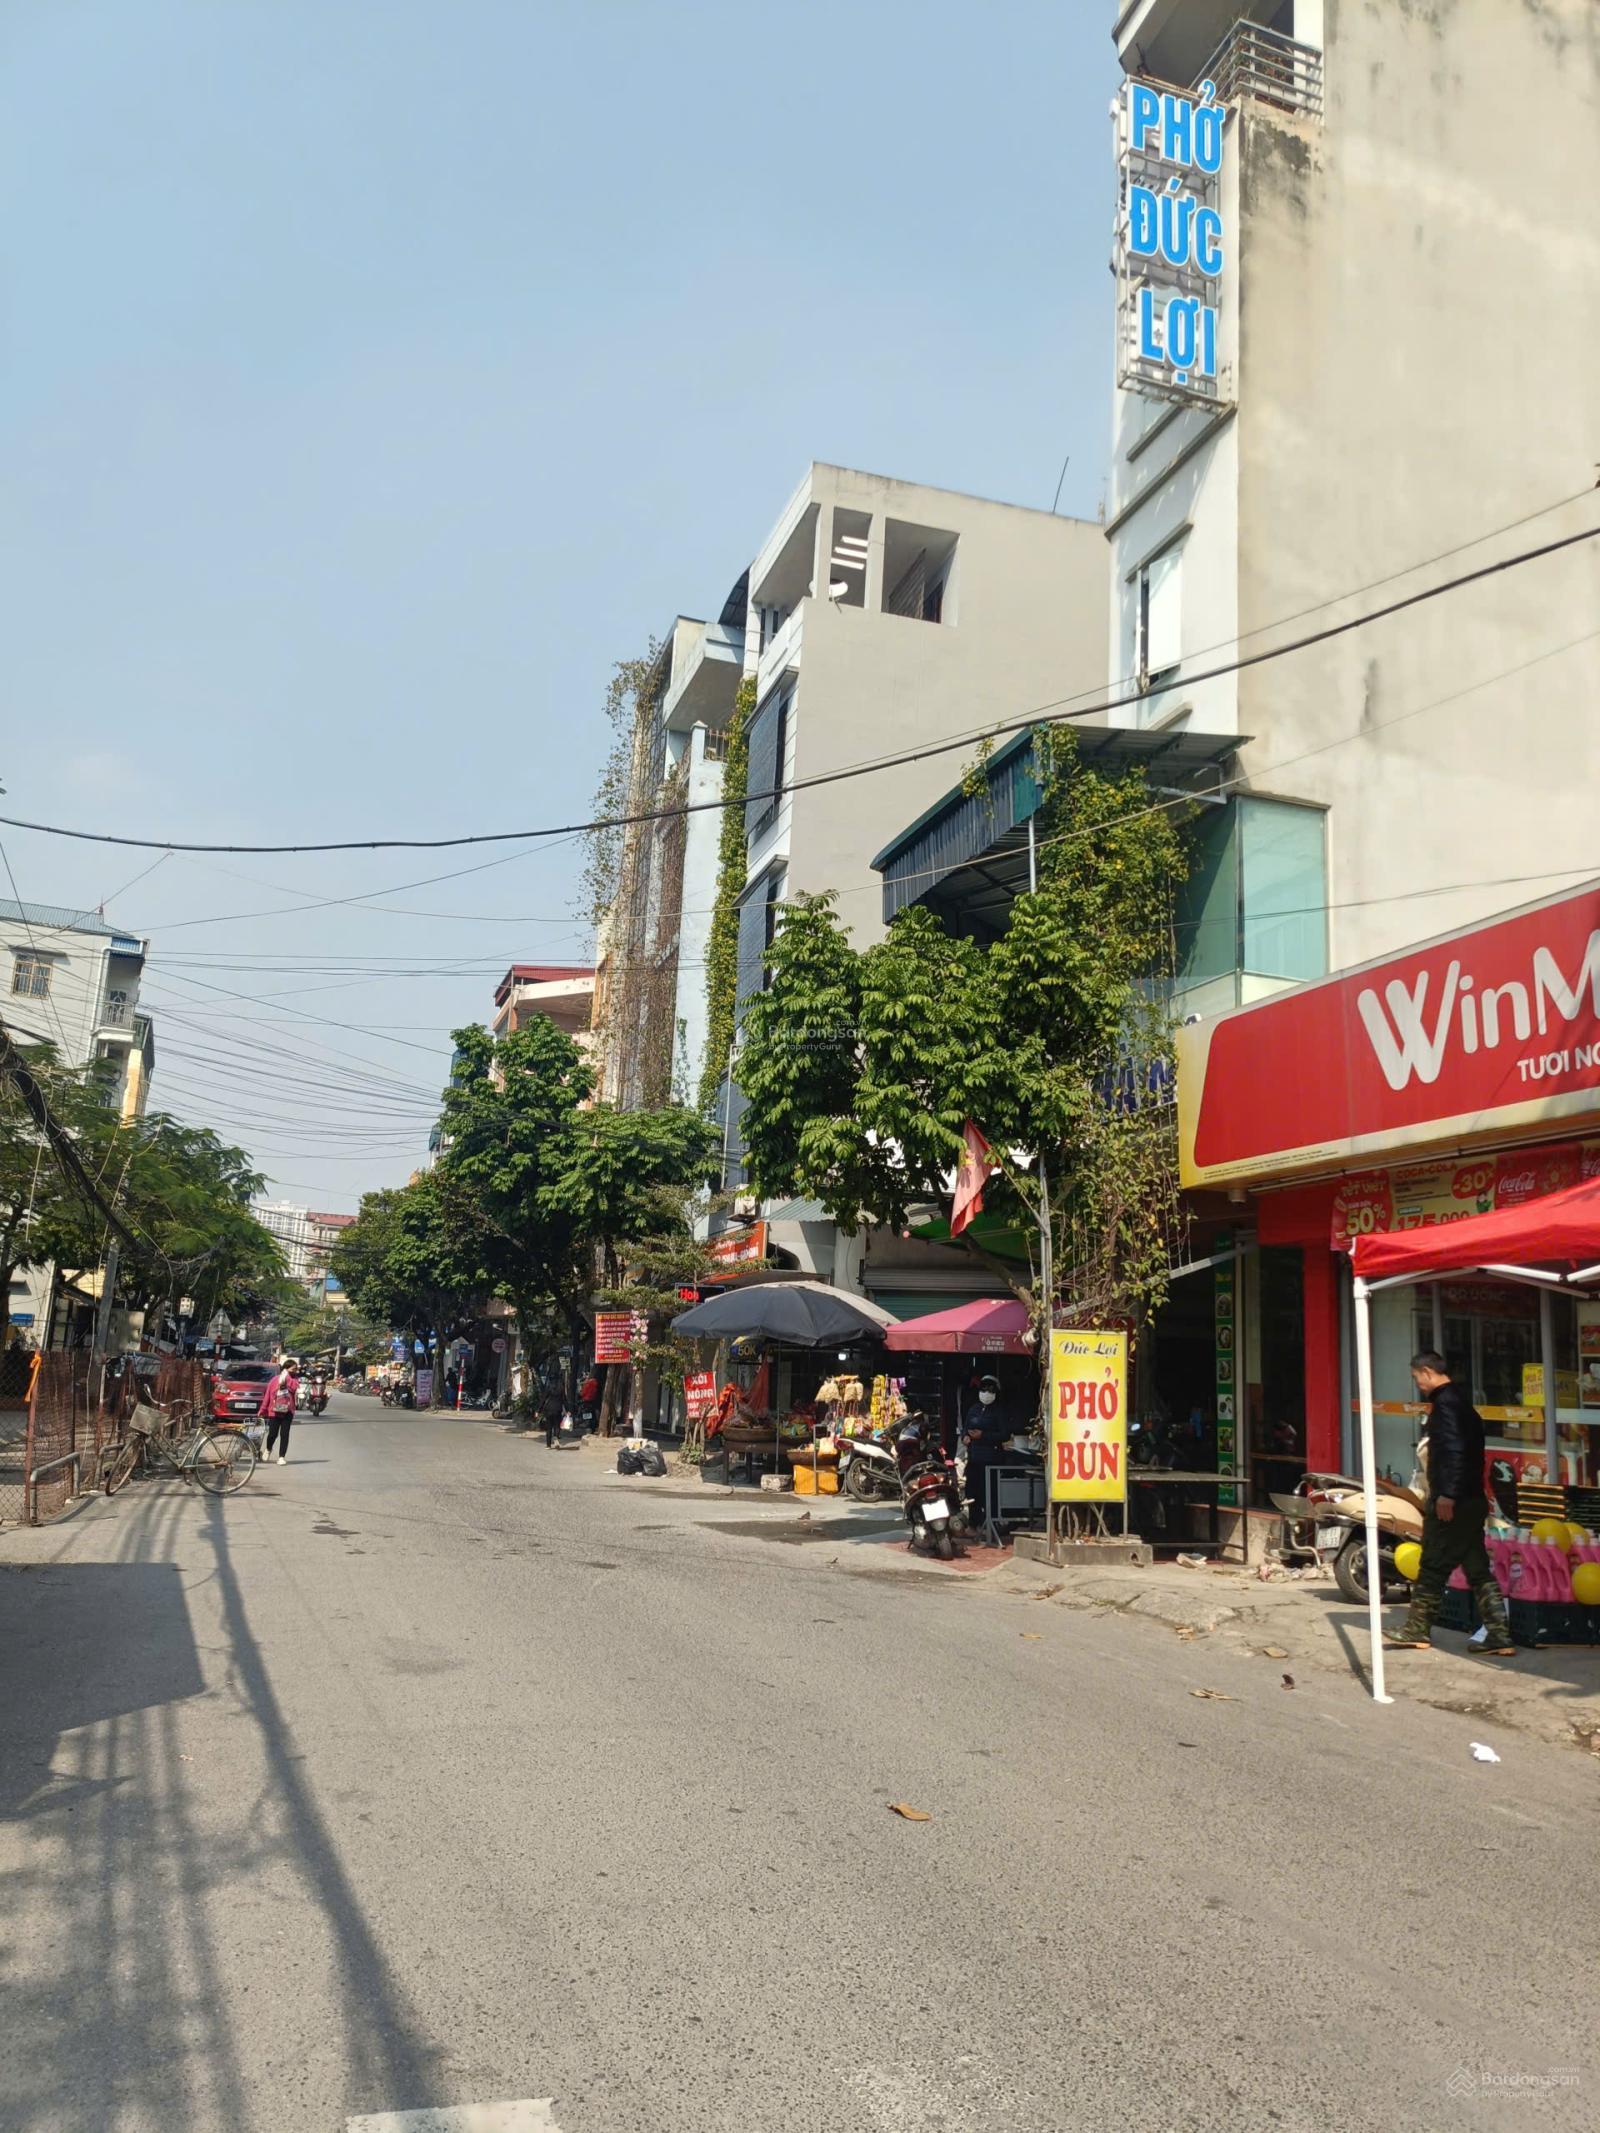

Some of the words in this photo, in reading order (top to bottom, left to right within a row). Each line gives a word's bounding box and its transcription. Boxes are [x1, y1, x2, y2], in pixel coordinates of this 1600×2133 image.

[1129, 79, 1226, 174] PHỞ
[1128, 177, 1224, 276] ĐỨC
[1138, 287, 1217, 385] LỢI
[1516, 1049, 1570, 1082] TƯƠI
[1060, 1340, 1090, 1355] Đức
[1094, 1340, 1119, 1358] Lợi
[1058, 1366, 1119, 1420] PHỞ
[1056, 1430, 1120, 1481] BÚN
